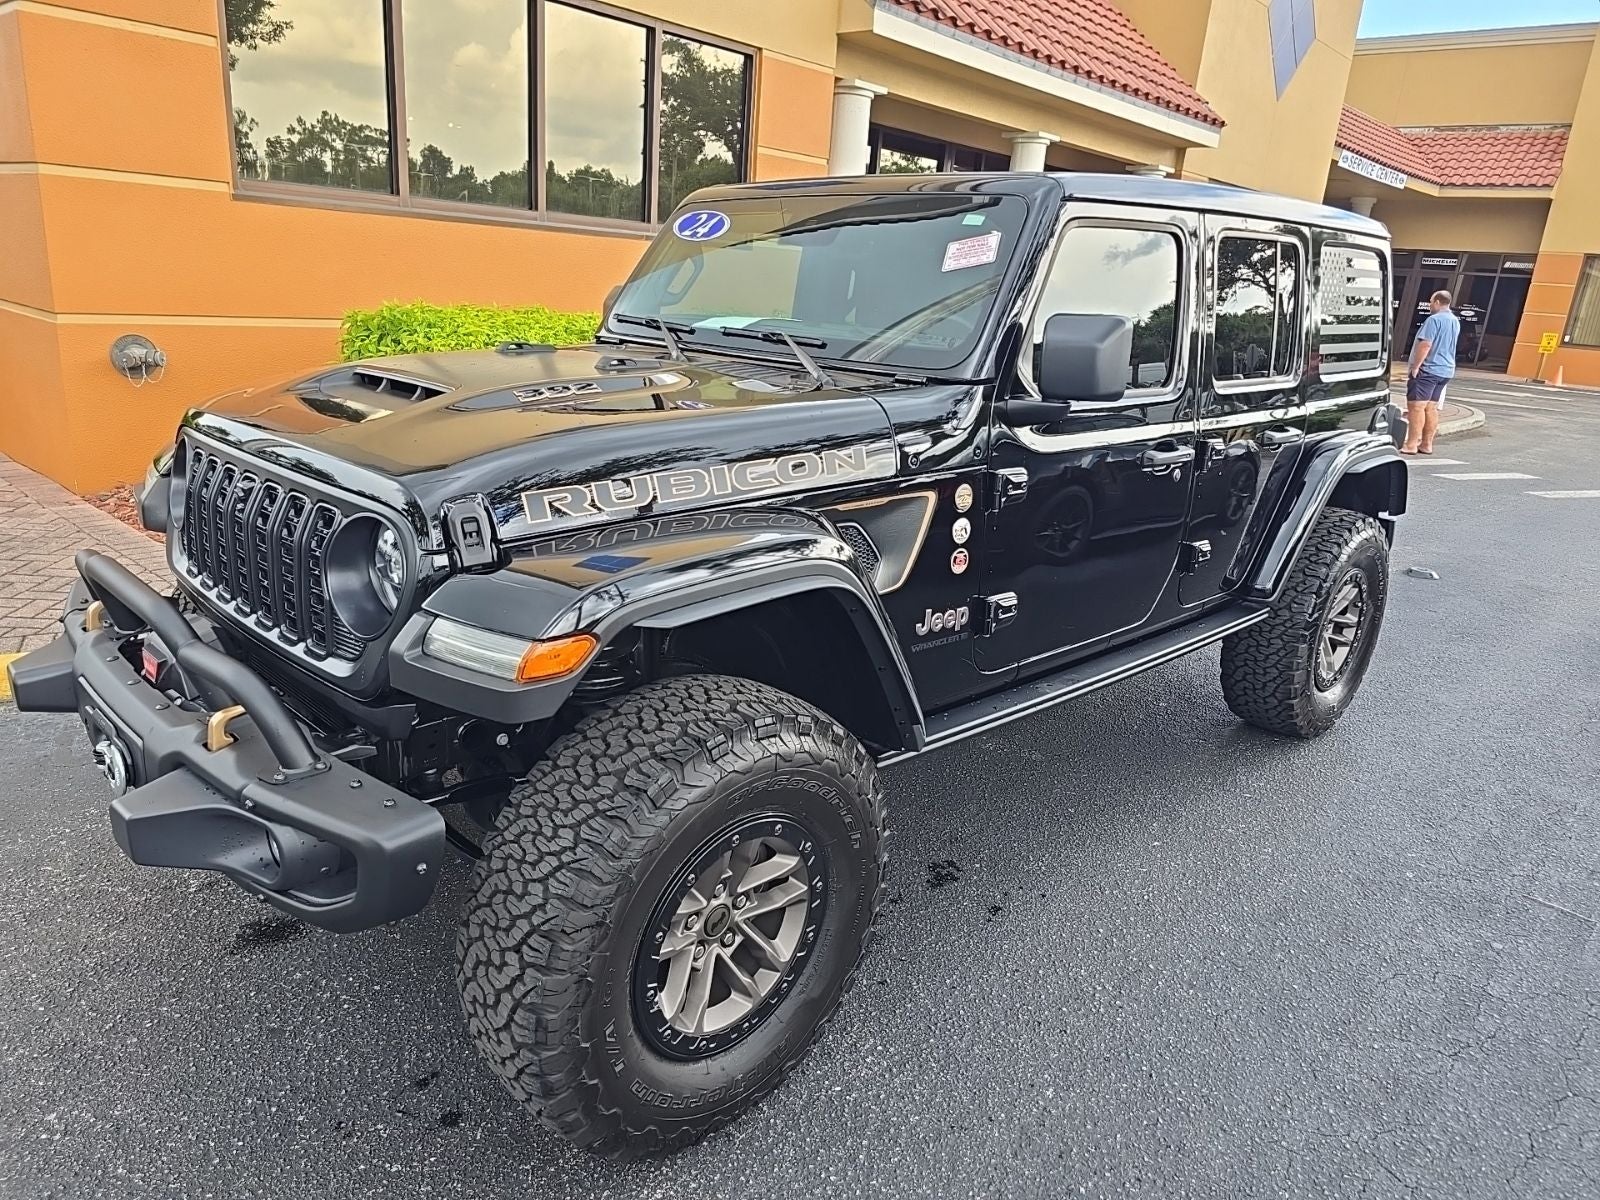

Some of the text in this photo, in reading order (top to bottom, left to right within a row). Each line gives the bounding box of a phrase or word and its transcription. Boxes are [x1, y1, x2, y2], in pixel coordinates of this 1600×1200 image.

[1348, 155, 1400, 184] SERVICE CENTER
[680, 214, 722, 237] 24
[513, 381, 603, 402] 392
[521, 446, 868, 524] RUBICON
[915, 606, 969, 636] Jeep
